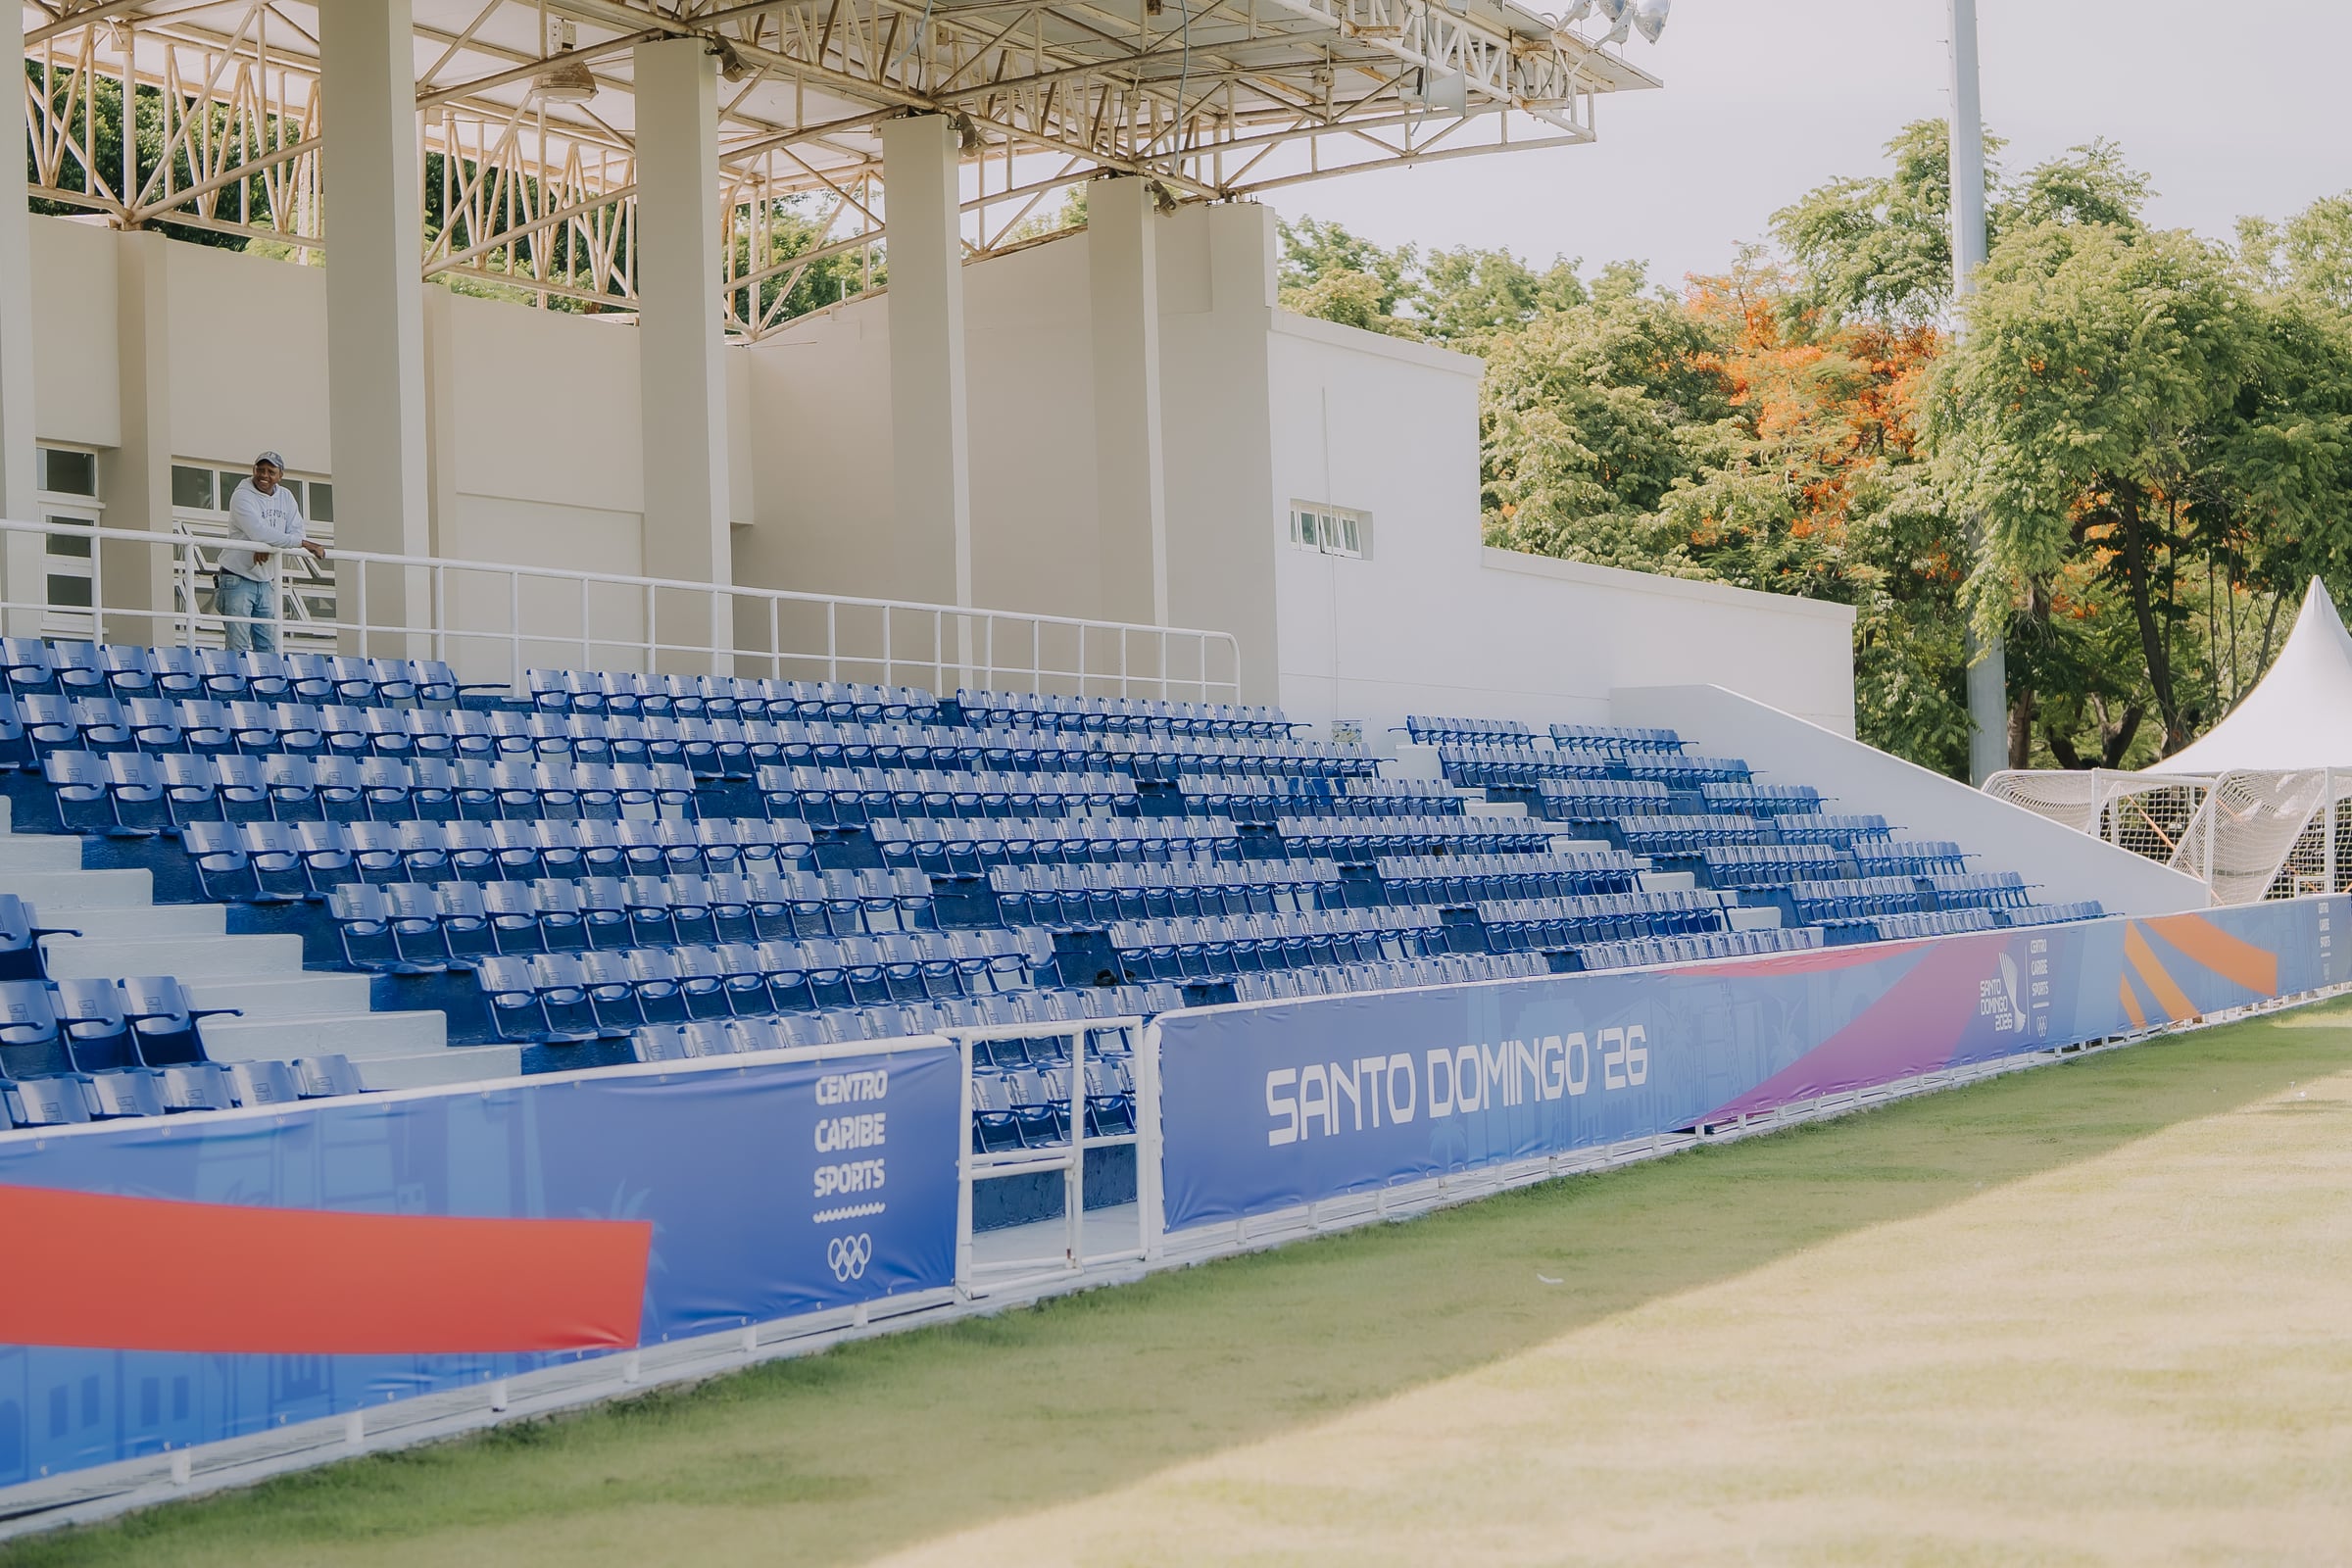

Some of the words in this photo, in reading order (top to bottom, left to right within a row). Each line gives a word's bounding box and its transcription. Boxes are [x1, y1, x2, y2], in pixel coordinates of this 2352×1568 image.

[1980, 978, 2002, 998] SANTO
[1980, 996, 2008, 1016] DOMINGO
[1994, 1012, 2013, 1032] 2026
[815, 1069, 889, 1105] CENTRO
[1265, 1053, 1417, 1147] SANTO
[1427, 1031, 1590, 1118] DOMINGO
[814, 1112, 886, 1152] CARIBE
[813, 1158, 886, 1198] SPORTS
